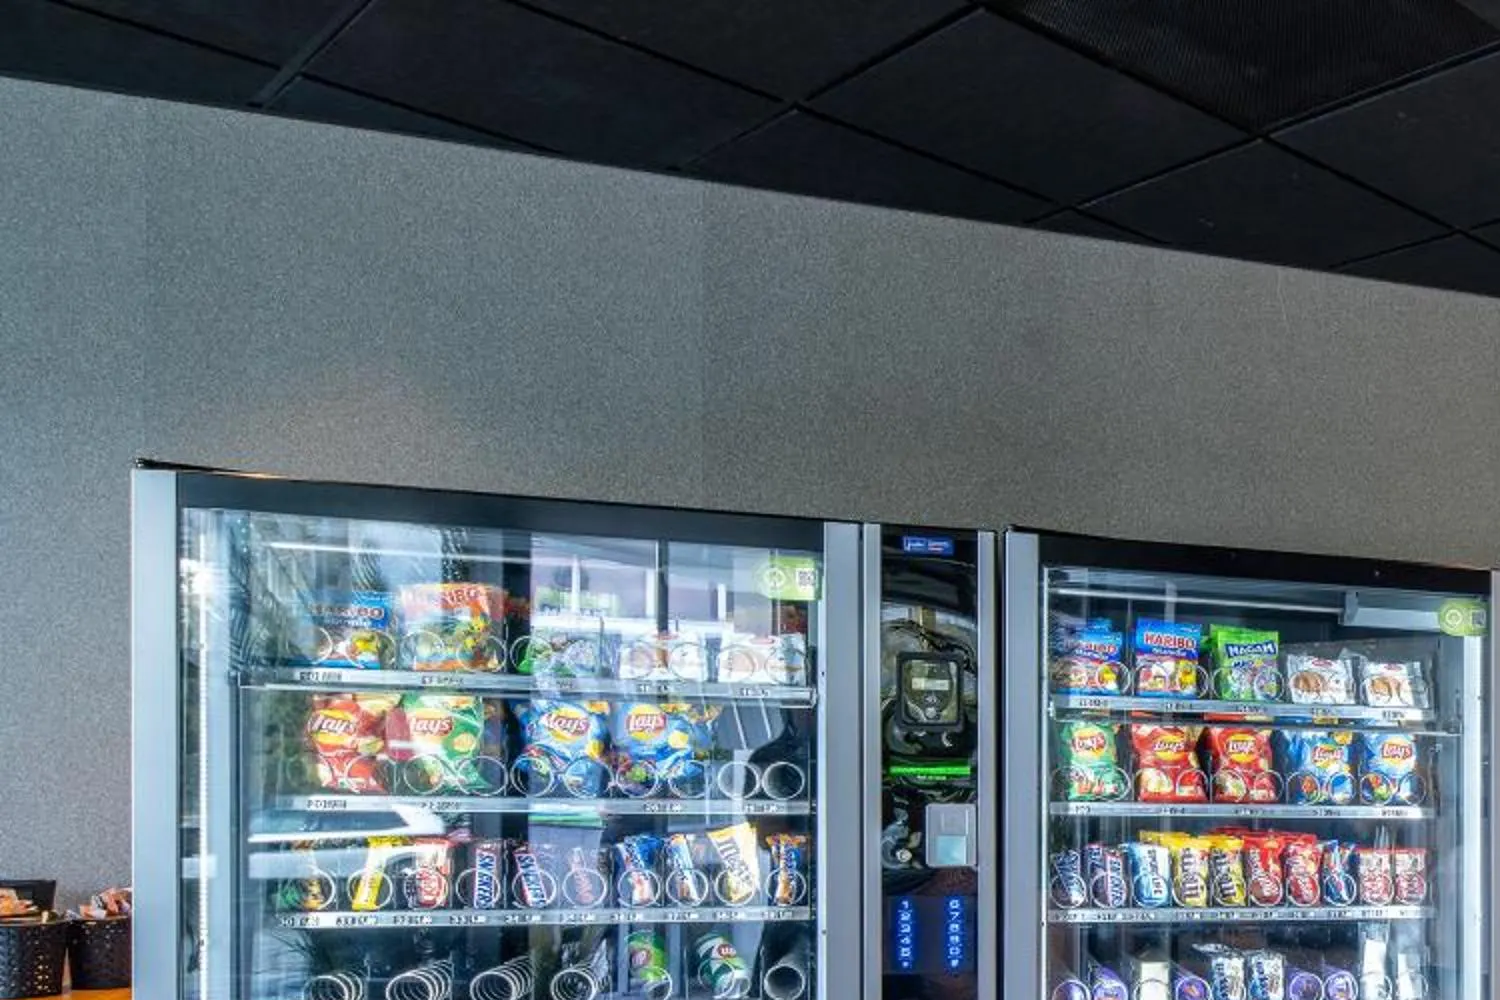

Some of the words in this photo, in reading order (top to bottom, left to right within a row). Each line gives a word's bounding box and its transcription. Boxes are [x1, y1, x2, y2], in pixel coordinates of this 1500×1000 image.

[1144, 631, 1197, 649] HARIBO
[1227, 642, 1276, 657] MAOAM
[477, 854, 495, 908] SNCKERS
[1109, 860, 1124, 906] SNCKERS
